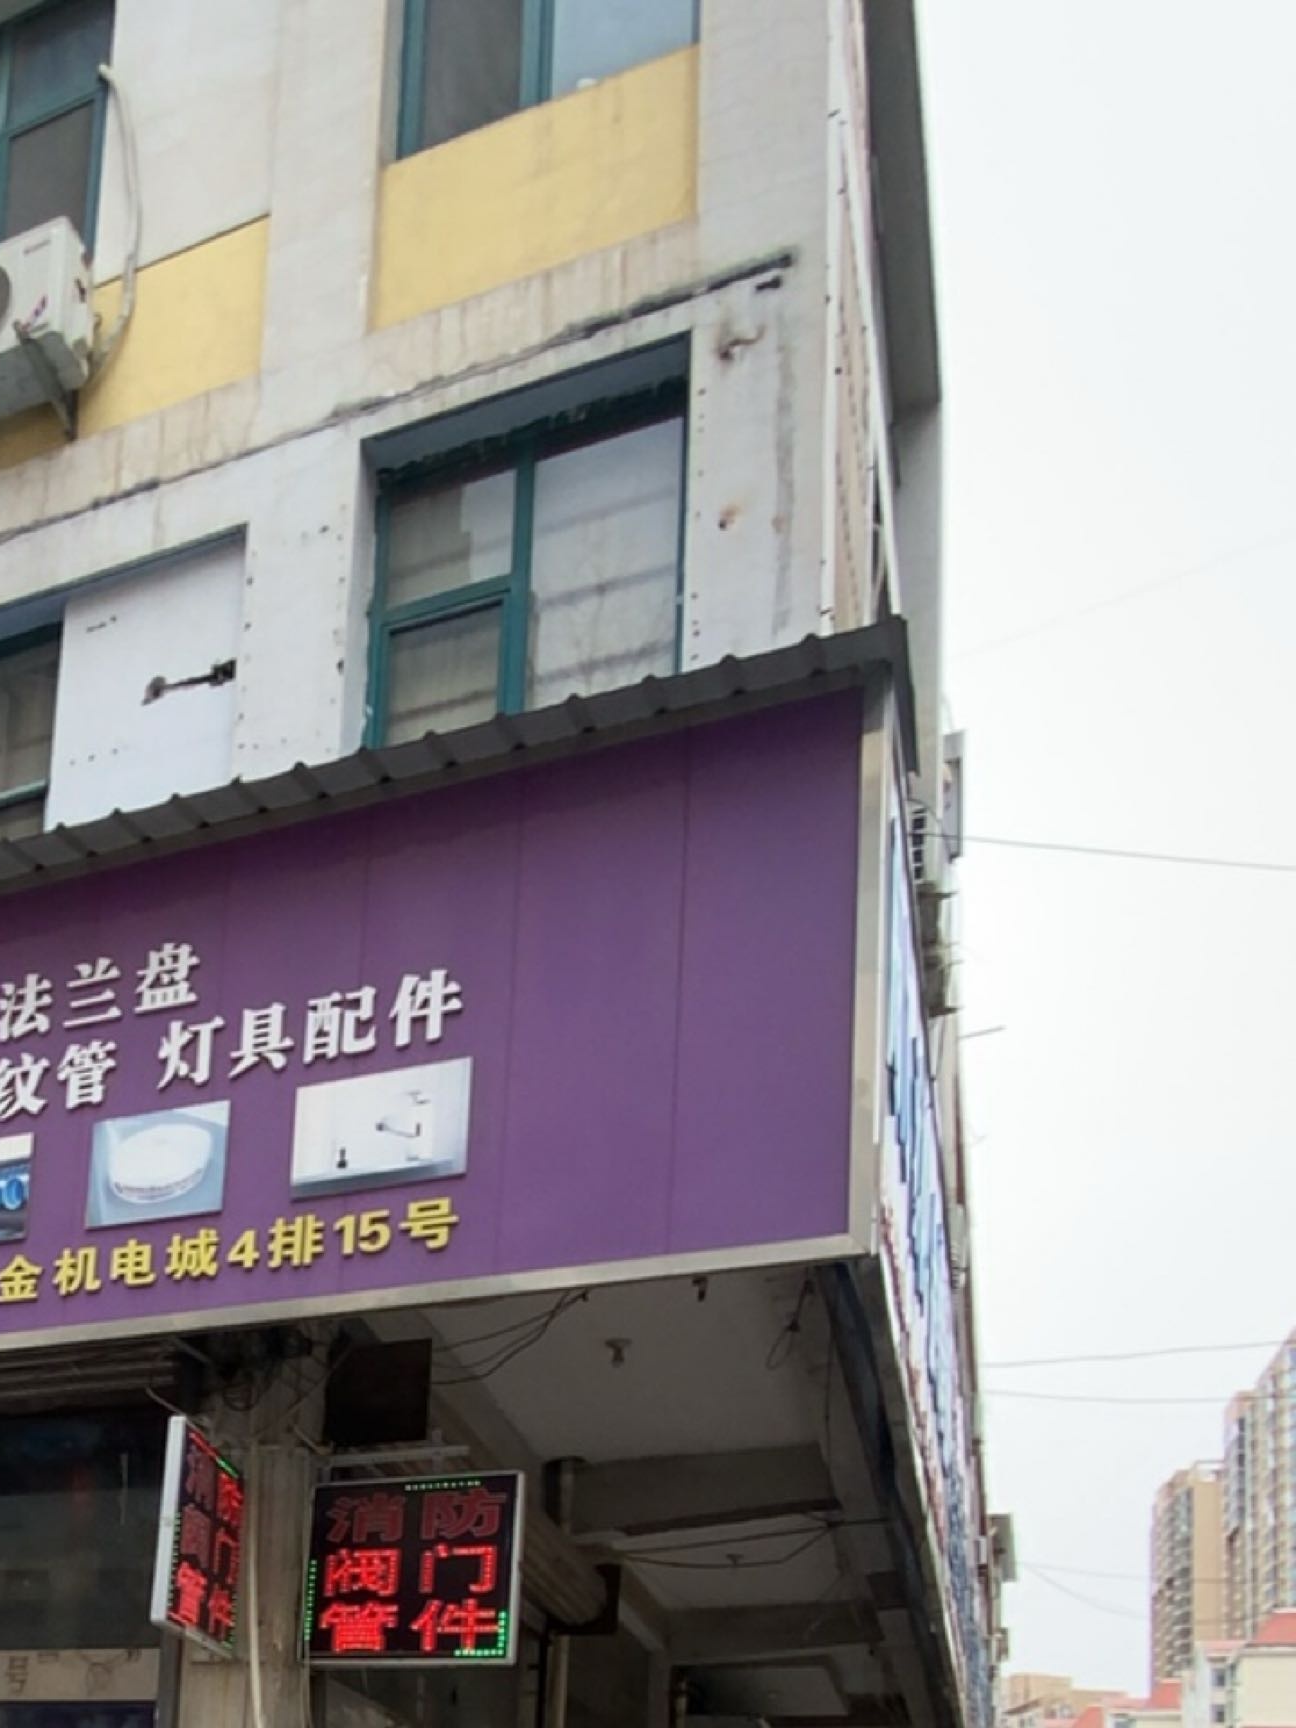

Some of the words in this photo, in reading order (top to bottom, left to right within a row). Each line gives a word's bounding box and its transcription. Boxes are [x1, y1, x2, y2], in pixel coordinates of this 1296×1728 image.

[156, 969, 464, 1091] 灯具配件
[325, 1490, 507, 1543] 消防
[323, 1545, 497, 1598] 阀门
[318, 1599, 501, 1652] 管件
